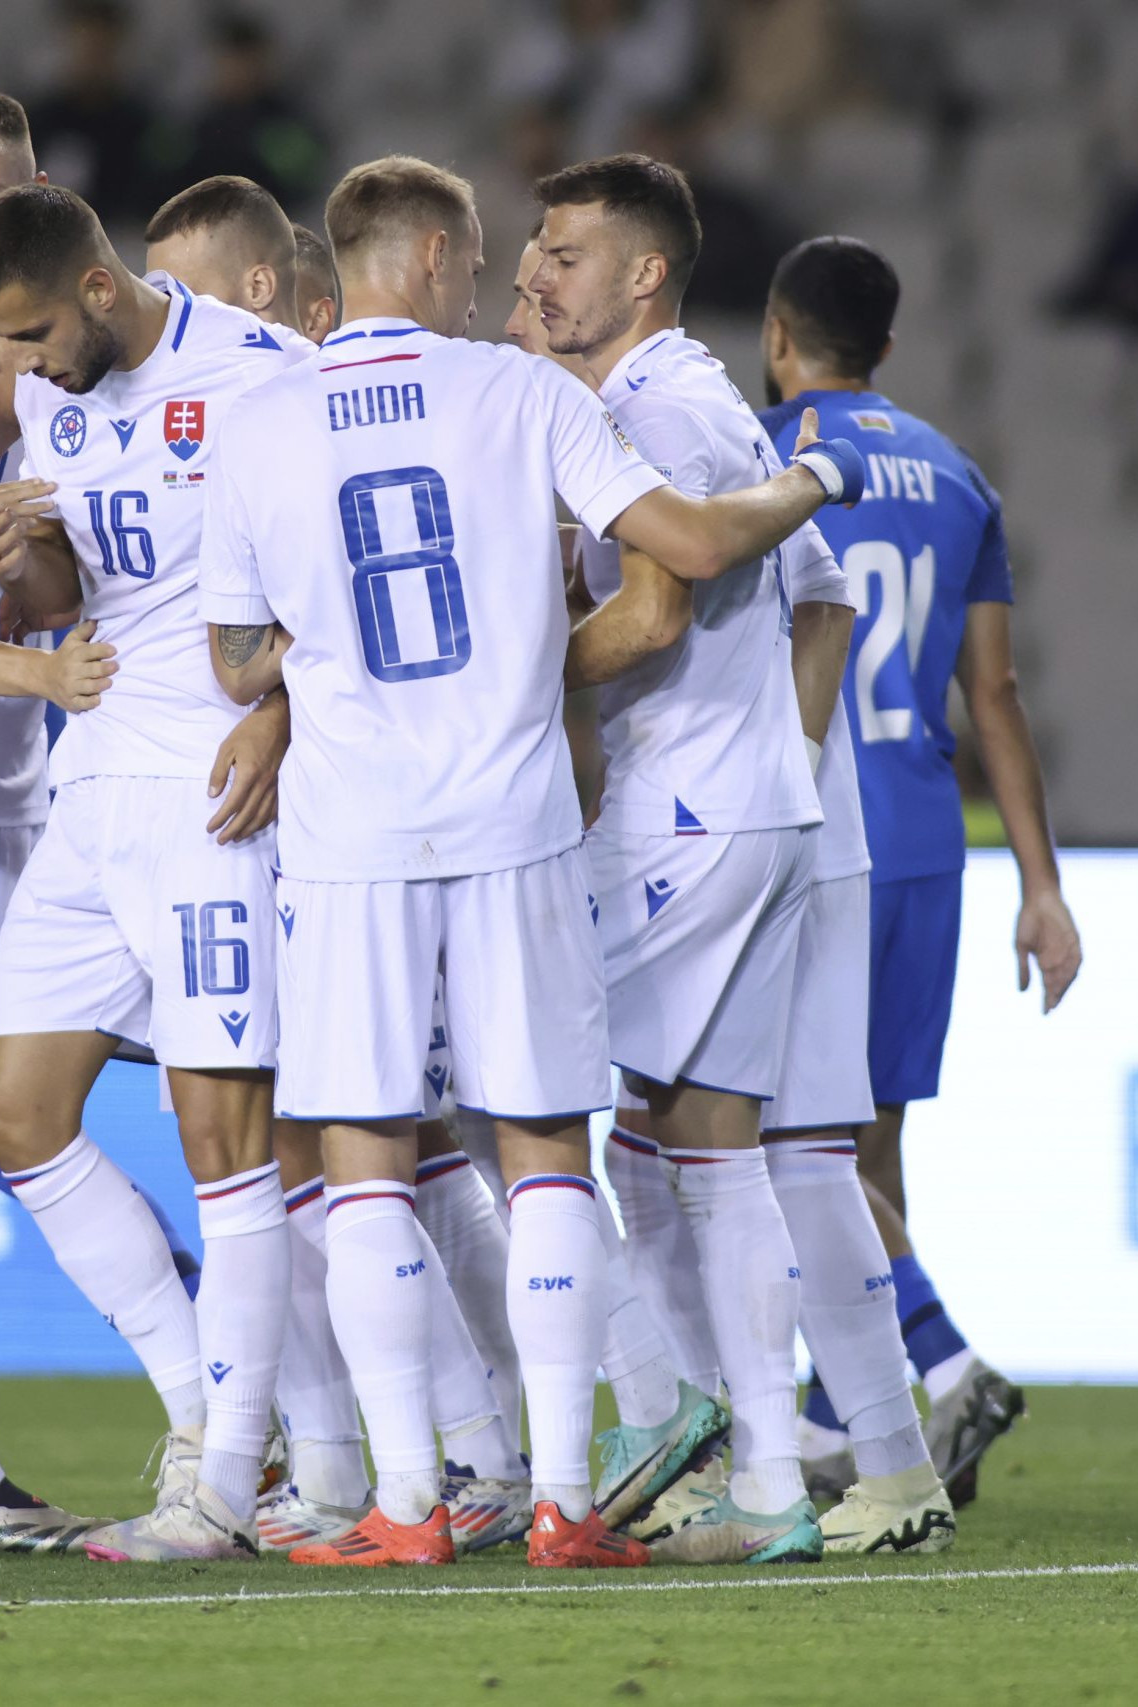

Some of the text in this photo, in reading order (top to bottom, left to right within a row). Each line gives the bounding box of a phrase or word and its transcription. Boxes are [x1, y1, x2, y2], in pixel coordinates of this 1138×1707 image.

[327, 382, 426, 432] DUDA
[83, 490, 156, 580] 16
[338, 465, 472, 683] 8
[841, 540, 935, 745] 21
[172, 900, 250, 998] 16
[395, 1258, 427, 1278] SVK
[528, 1275, 575, 1291] SVK
